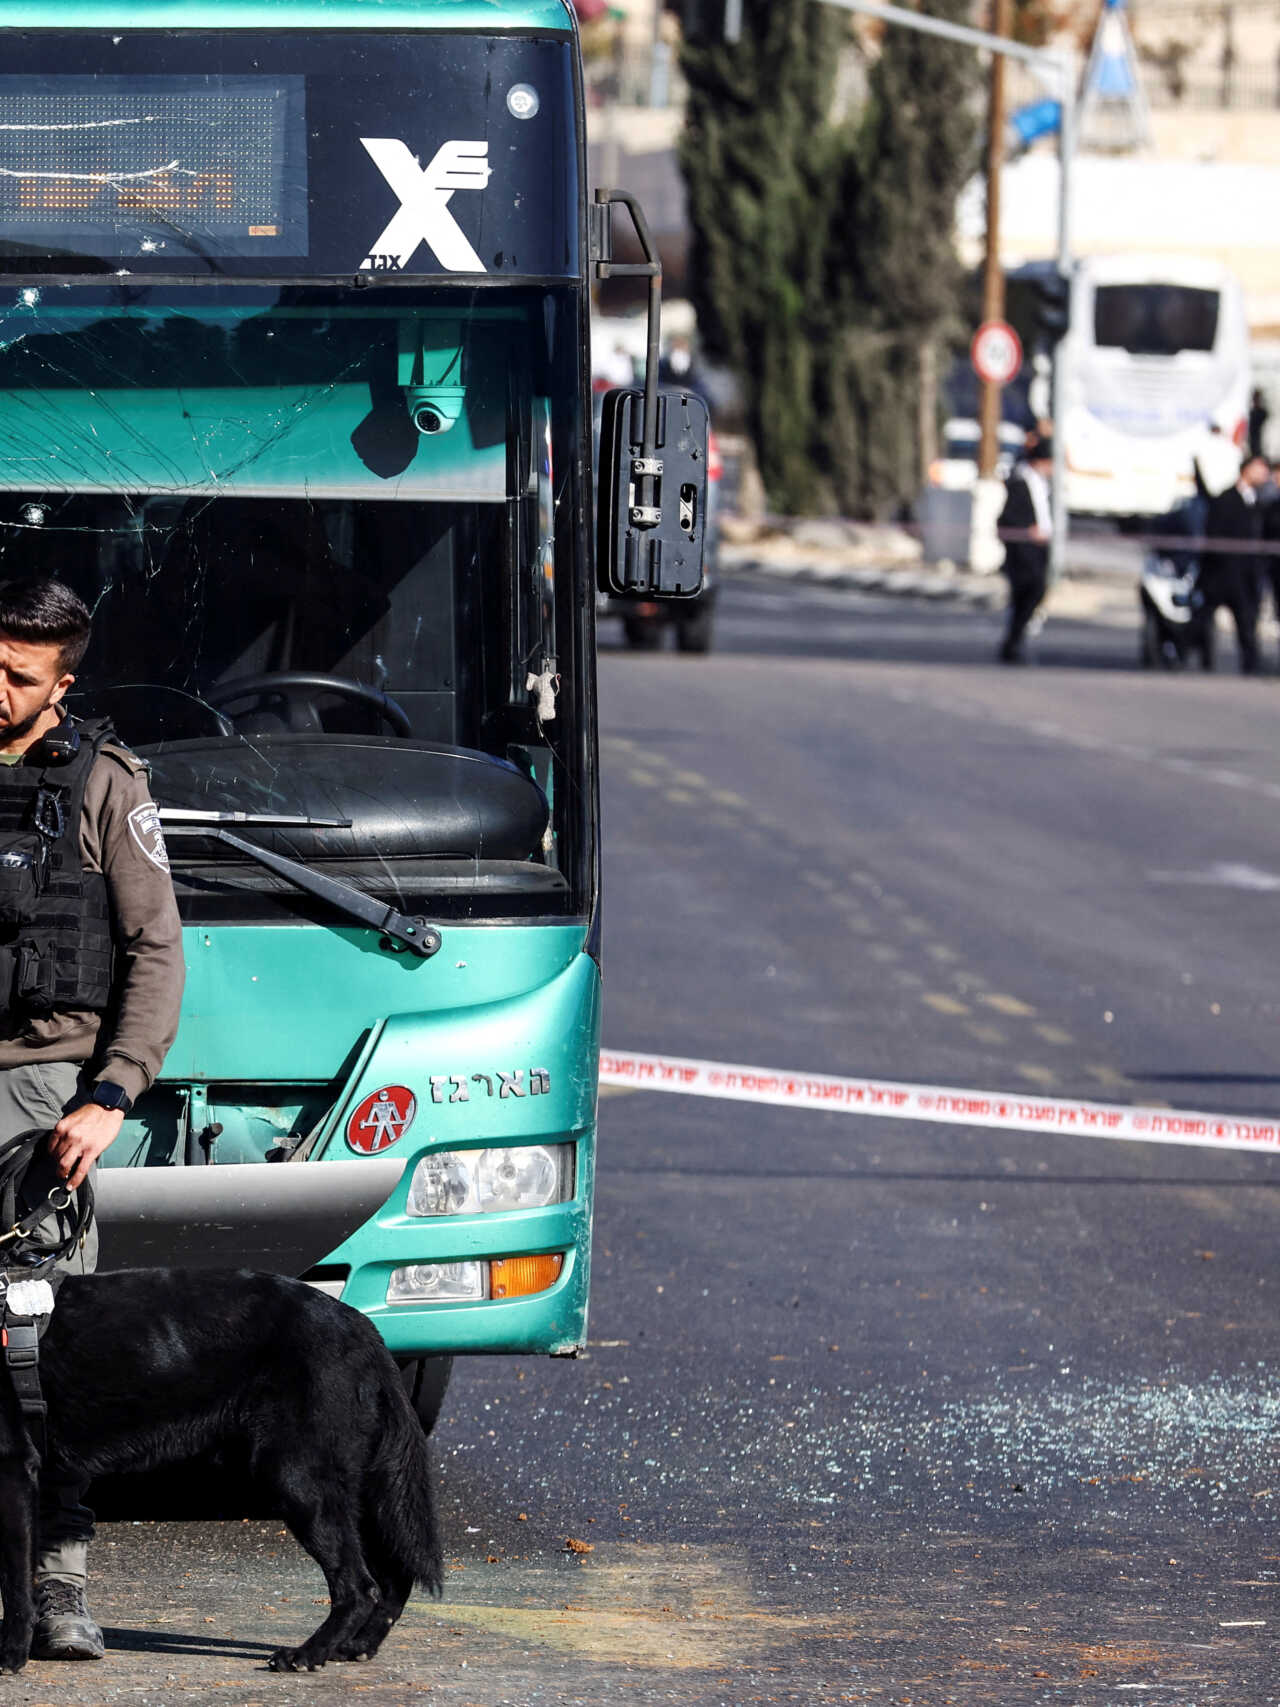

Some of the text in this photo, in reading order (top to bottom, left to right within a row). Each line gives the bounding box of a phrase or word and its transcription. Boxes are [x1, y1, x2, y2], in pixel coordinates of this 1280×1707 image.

[368, 254, 402, 271] אגד
[428, 1066, 551, 1104] הארגז
[725, 1071, 779, 1094] משטרת
[935, 1094, 991, 1116] משטרת
[1151, 1114, 1207, 1136] משטרת
